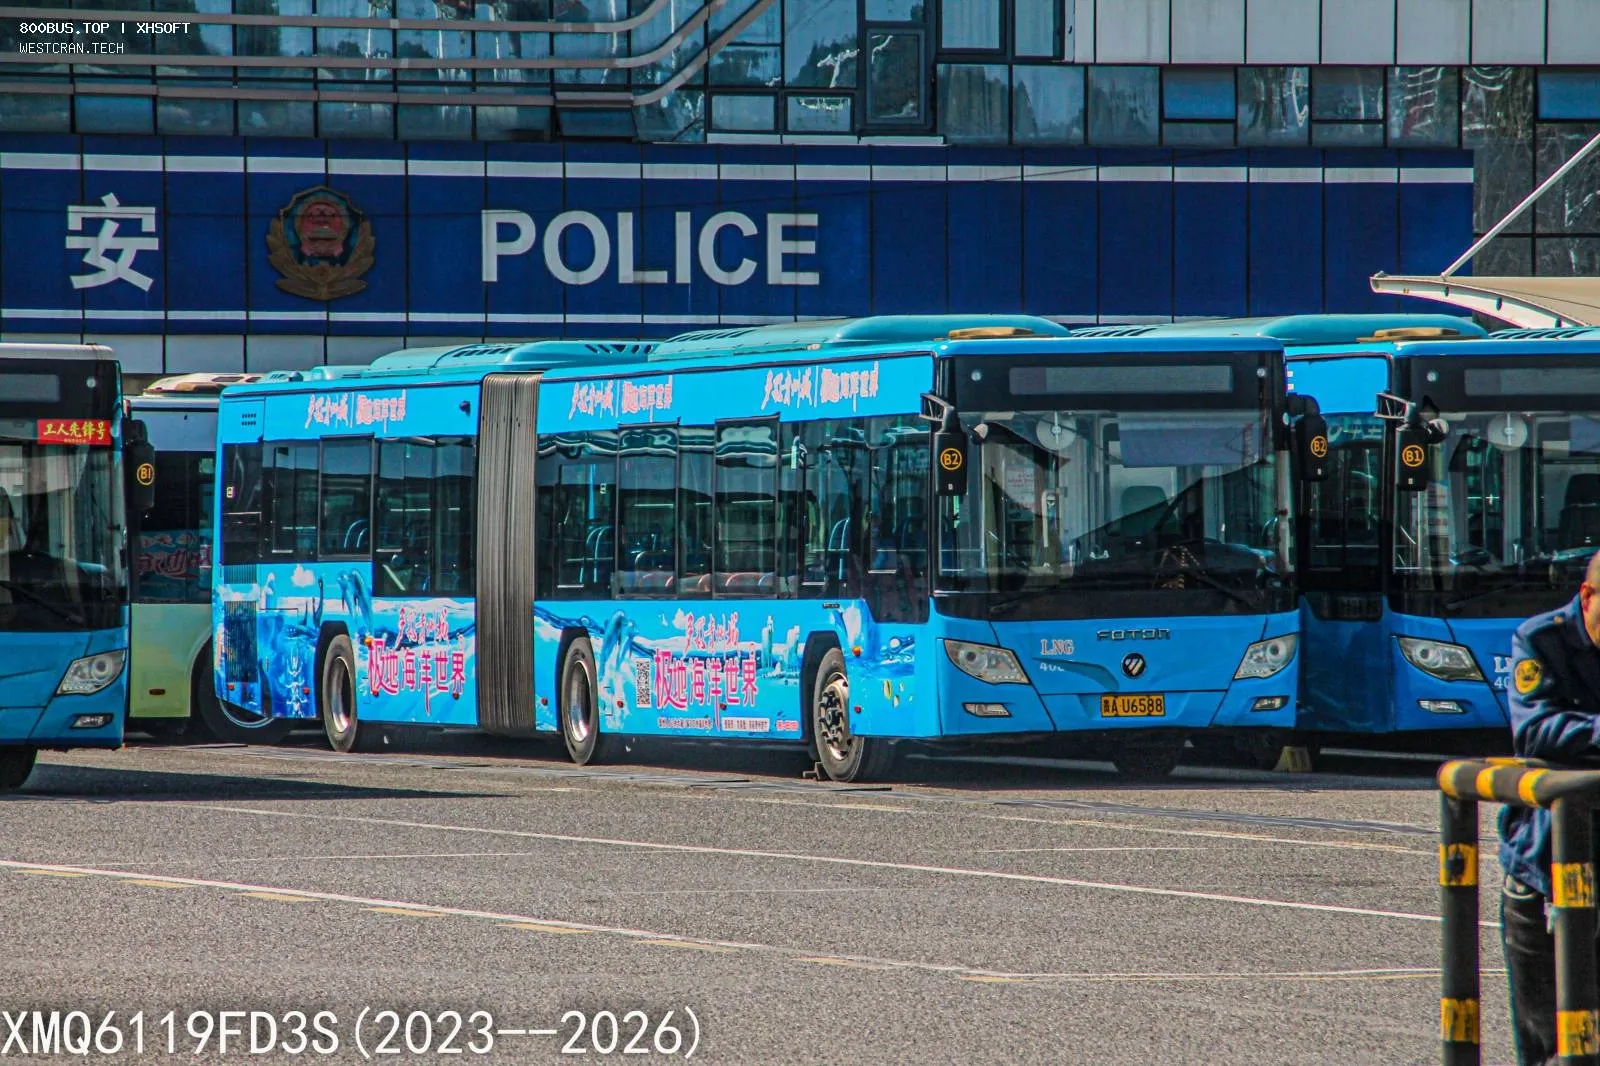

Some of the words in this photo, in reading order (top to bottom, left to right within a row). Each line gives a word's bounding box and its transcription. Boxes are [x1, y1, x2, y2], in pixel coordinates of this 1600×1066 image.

[65, 192, 159, 292] 安
[481, 210, 820, 285] POLICE
[43, 421, 106, 440] 工人先锋号
[1313, 440, 1327, 452] B2
[943, 453, 959, 466] B2
[1405, 449, 1421, 462] B1
[1096, 628, 1172, 642] FOTON
[1040, 638, 1074, 656] LNG
[368, 636, 466, 716] 极地海洋世界
[653, 643, 759, 731] 极地海洋世界
